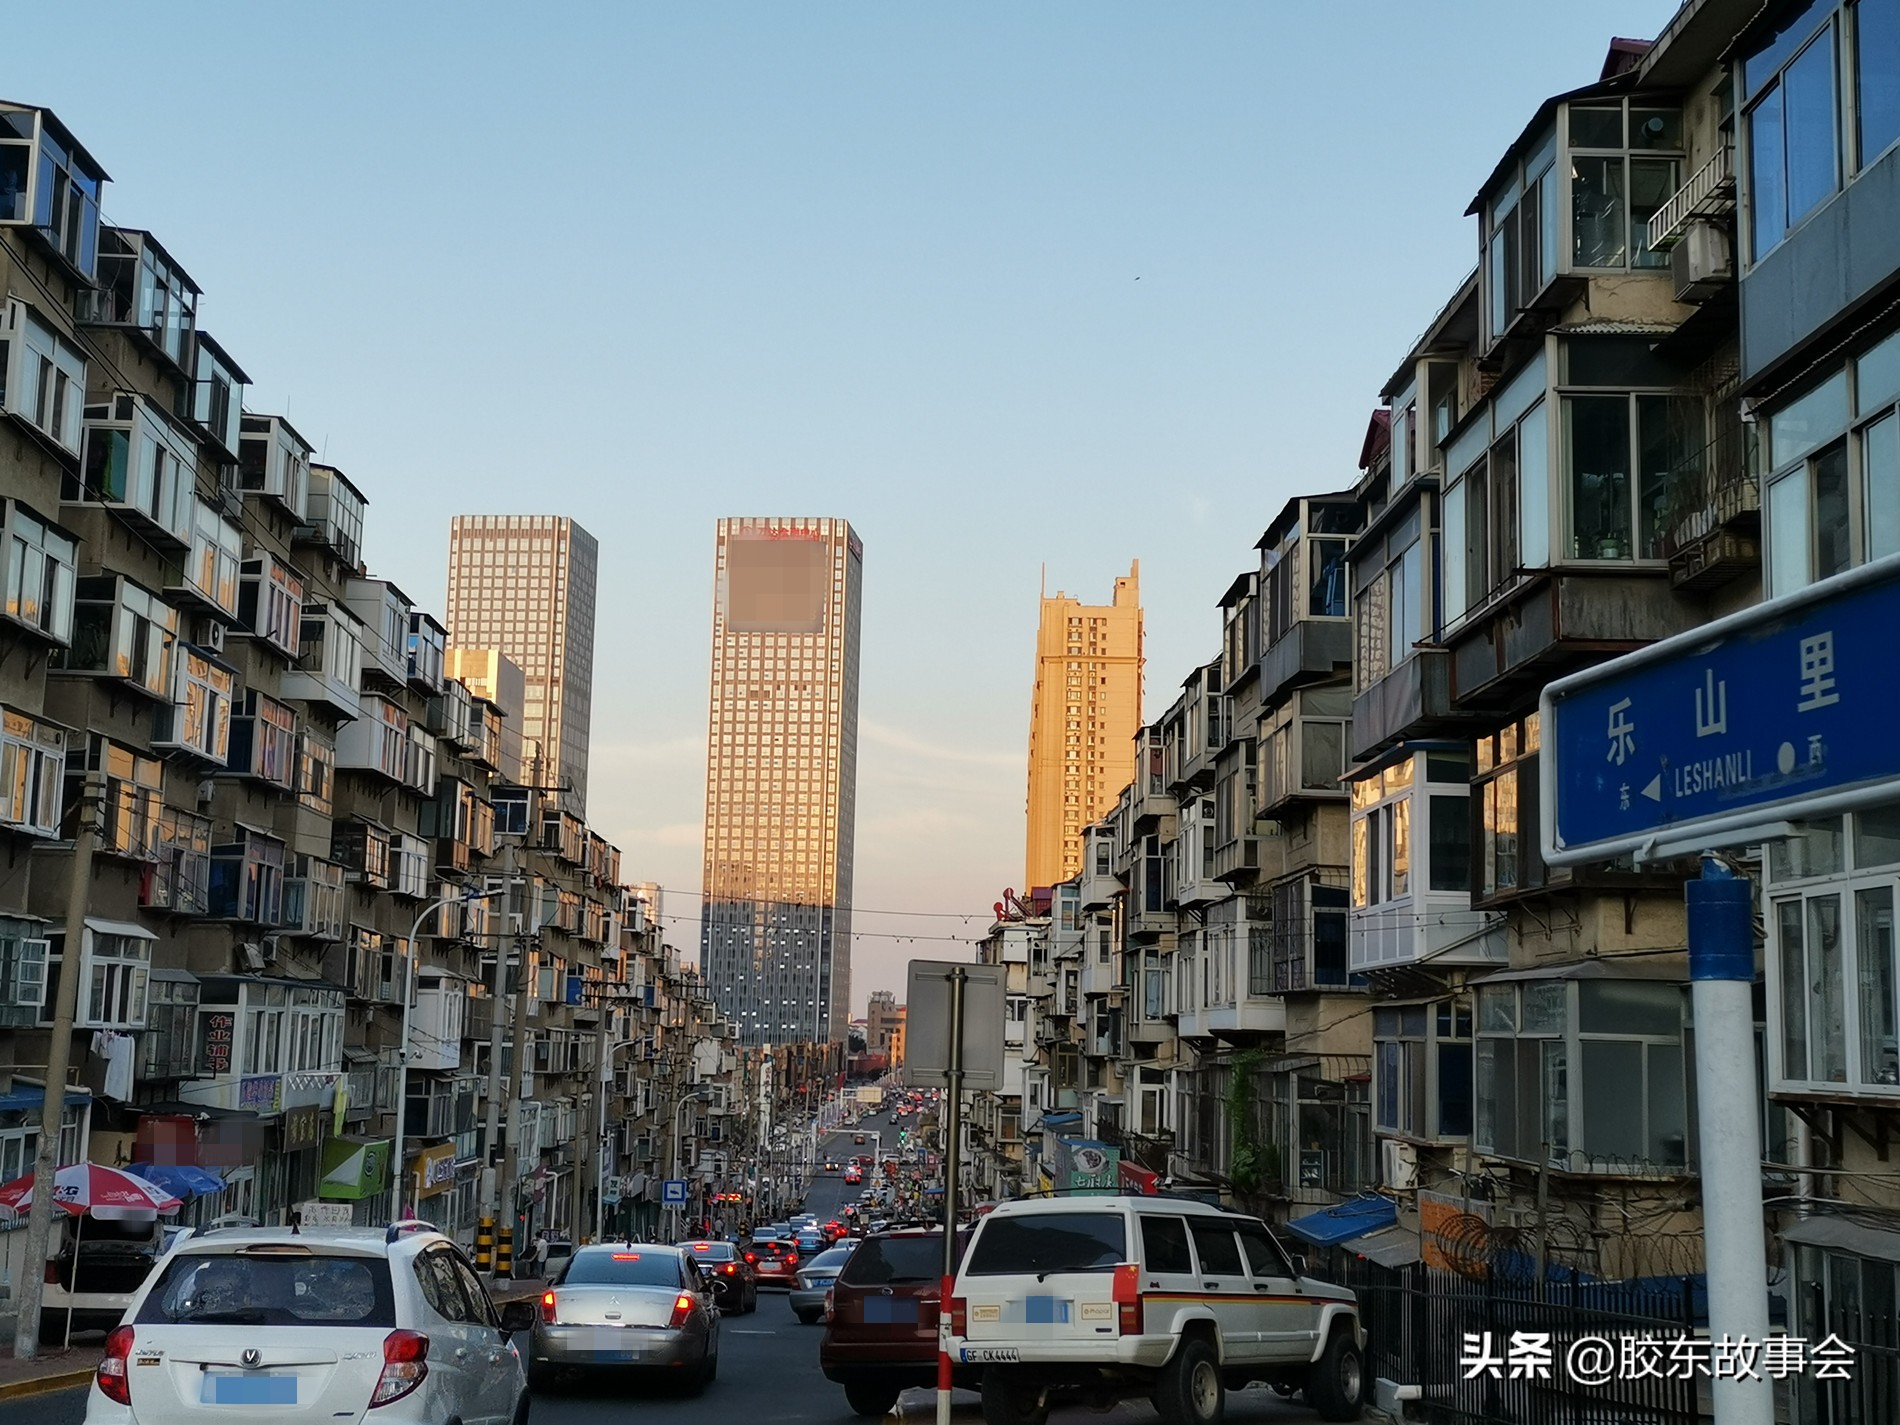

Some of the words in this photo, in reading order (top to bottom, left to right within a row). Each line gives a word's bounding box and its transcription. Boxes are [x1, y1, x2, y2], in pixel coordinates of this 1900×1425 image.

[1607, 631, 1840, 766] 乐山里
[1619, 782, 1631, 810] 东
[1675, 751, 1752, 798] LESHANLI
